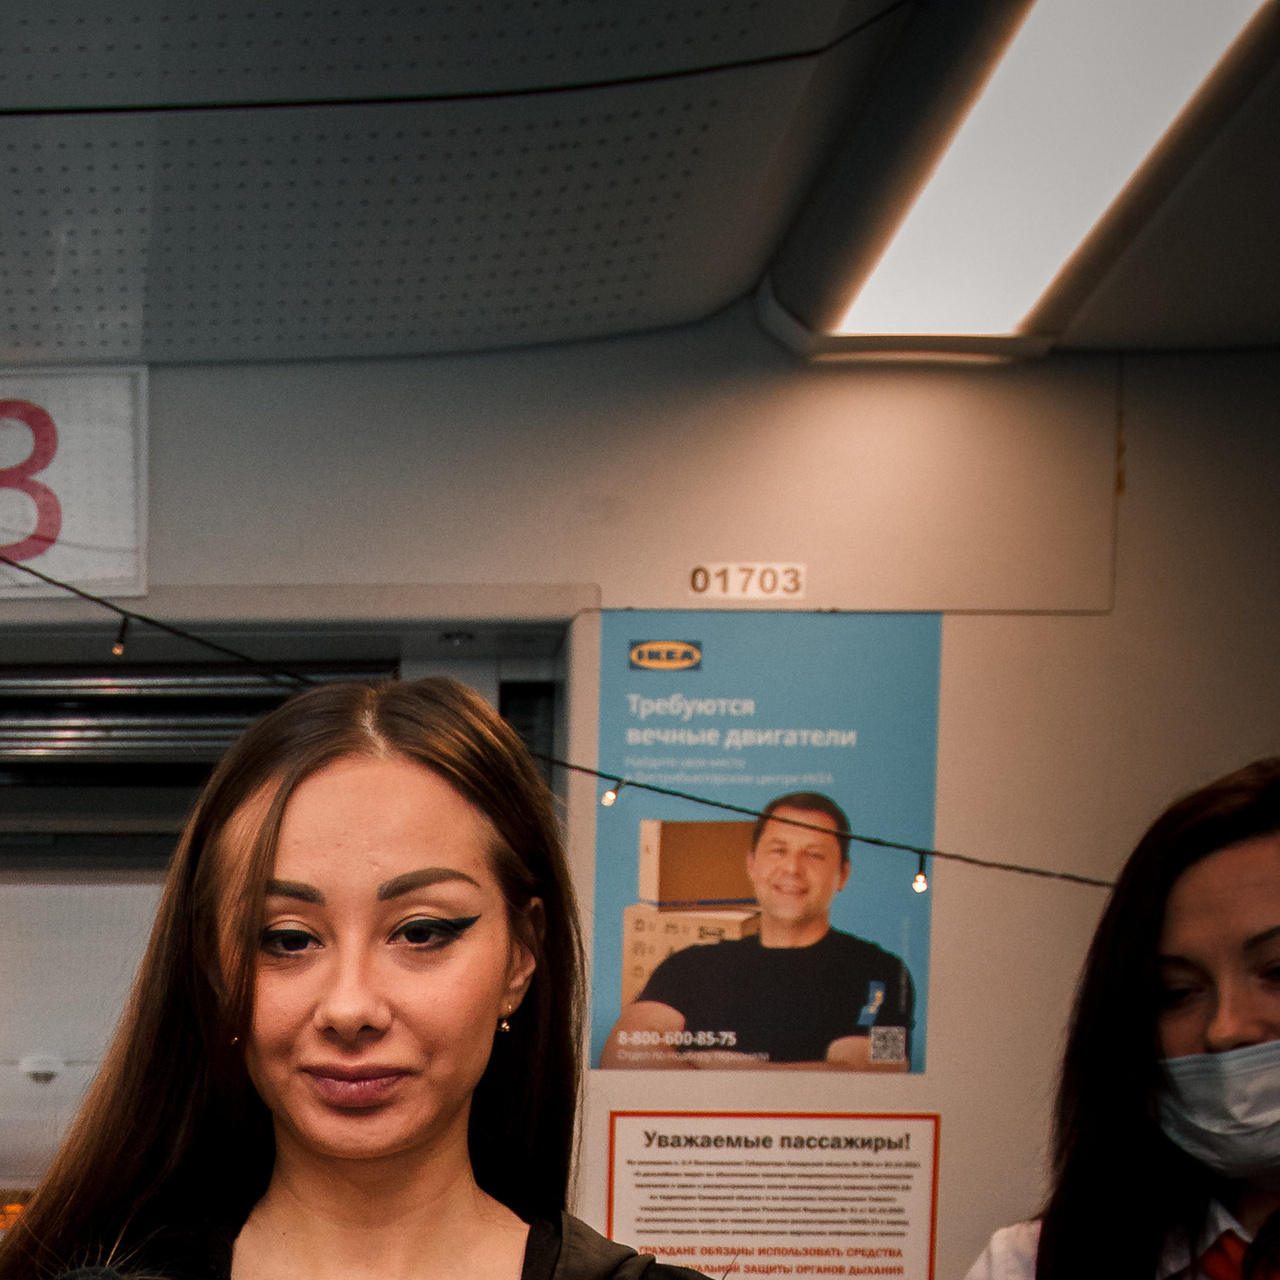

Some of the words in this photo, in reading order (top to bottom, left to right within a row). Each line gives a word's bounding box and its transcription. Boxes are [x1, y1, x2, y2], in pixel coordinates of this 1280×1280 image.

[691, 566, 801, 594] 01703
[627, 693, 756, 721] Требуются
[626, 727, 720, 746] вечные
[723, 728, 858, 751] двигатели
[617, 1030, 737, 1047] 8-800-600-85-75
[643, 1130, 773, 1150] Уважаемые
[780, 1132, 911, 1154] пассажиры!
[639, 1246, 696, 1256] ГРАЖДАНЕ
[700, 1246, 754, 1256] ОБЯЗАНЫ
[757, 1246, 843, 1257] ИСПОЛЬЗОВАТЬ
[846, 1247, 903, 1258] СРЕДСТВА
[743, 1264, 792, 1275] ЗАЩИТЫ
[796, 1265, 845, 1275] ОРГАНОВ
[848, 1265, 904, 1276] ДЫХАНИЯ
